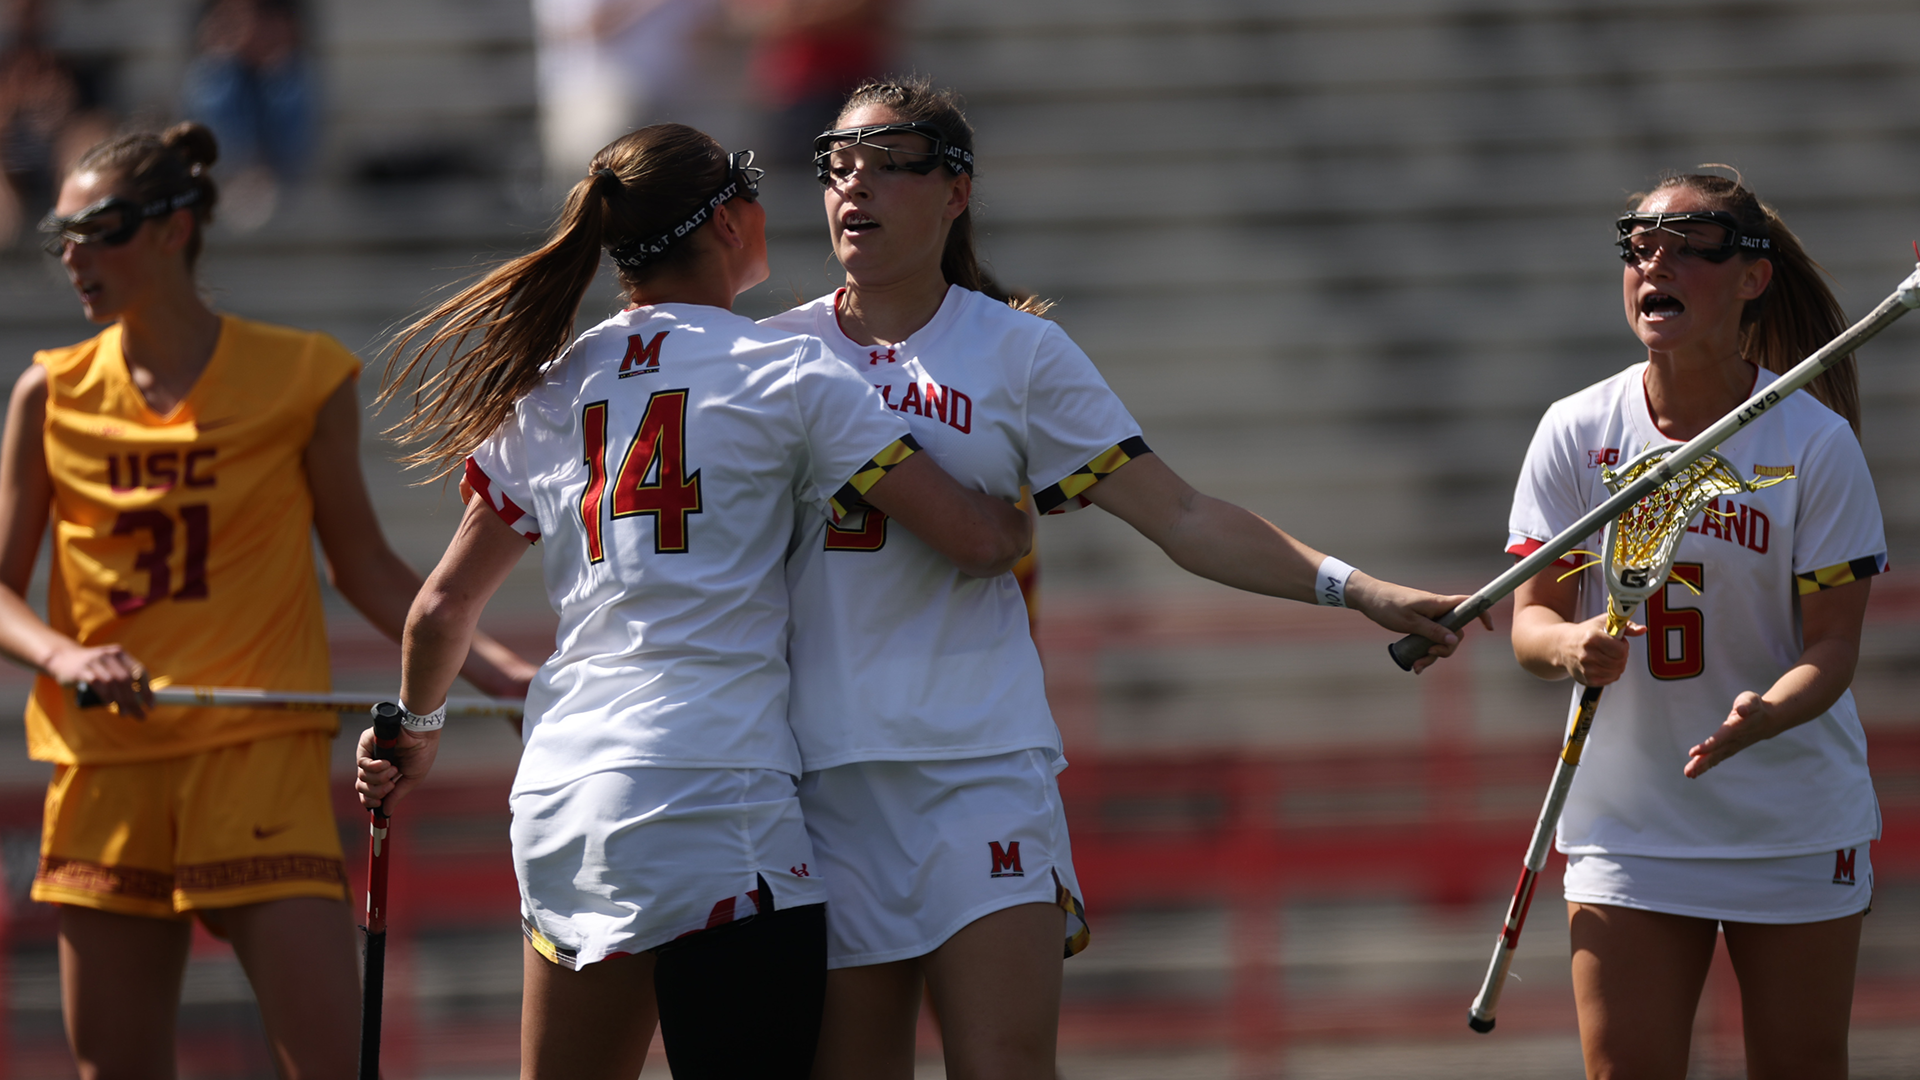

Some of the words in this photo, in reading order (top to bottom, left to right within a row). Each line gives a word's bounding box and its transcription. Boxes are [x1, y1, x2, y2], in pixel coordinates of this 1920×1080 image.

[674, 207, 707, 238] GAIT
[709, 182, 737, 209] GAIT
[619, 331, 670, 372] M
[874, 382, 973, 435] LAND
[1737, 390, 1780, 426] GAIT
[108, 448, 217, 494] USC
[579, 388, 703, 566] 14
[109, 503, 210, 616] 31
[1644, 561, 1704, 681] 6
[988, 841, 1024, 873] M
[1833, 847, 1856, 881] M
